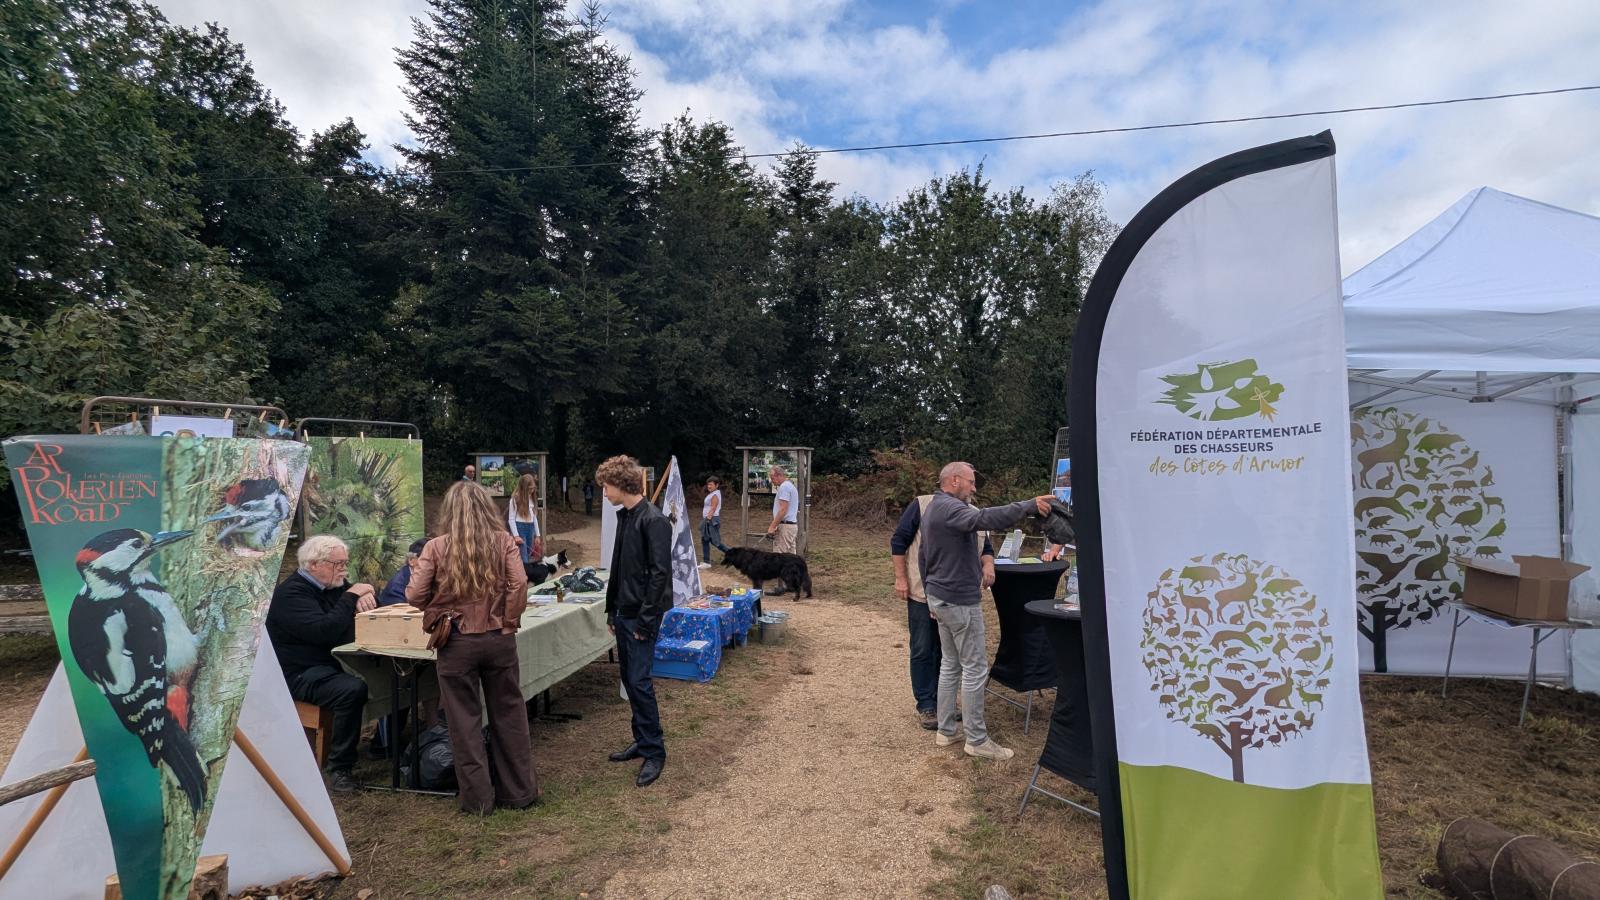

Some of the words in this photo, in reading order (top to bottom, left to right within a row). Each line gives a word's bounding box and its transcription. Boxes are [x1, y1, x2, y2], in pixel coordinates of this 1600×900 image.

[1130, 429, 1203, 442] FÉDÉRATION
[1206, 422, 1322, 440] DÉPARTEMENTALE
[24, 442, 65, 474] AR
[1174, 444, 1197, 454] DES
[1200, 442, 1274, 454] CHASSEURS
[1149, 456, 1180, 477] des
[1232, 454, 1305, 475] d'Armor
